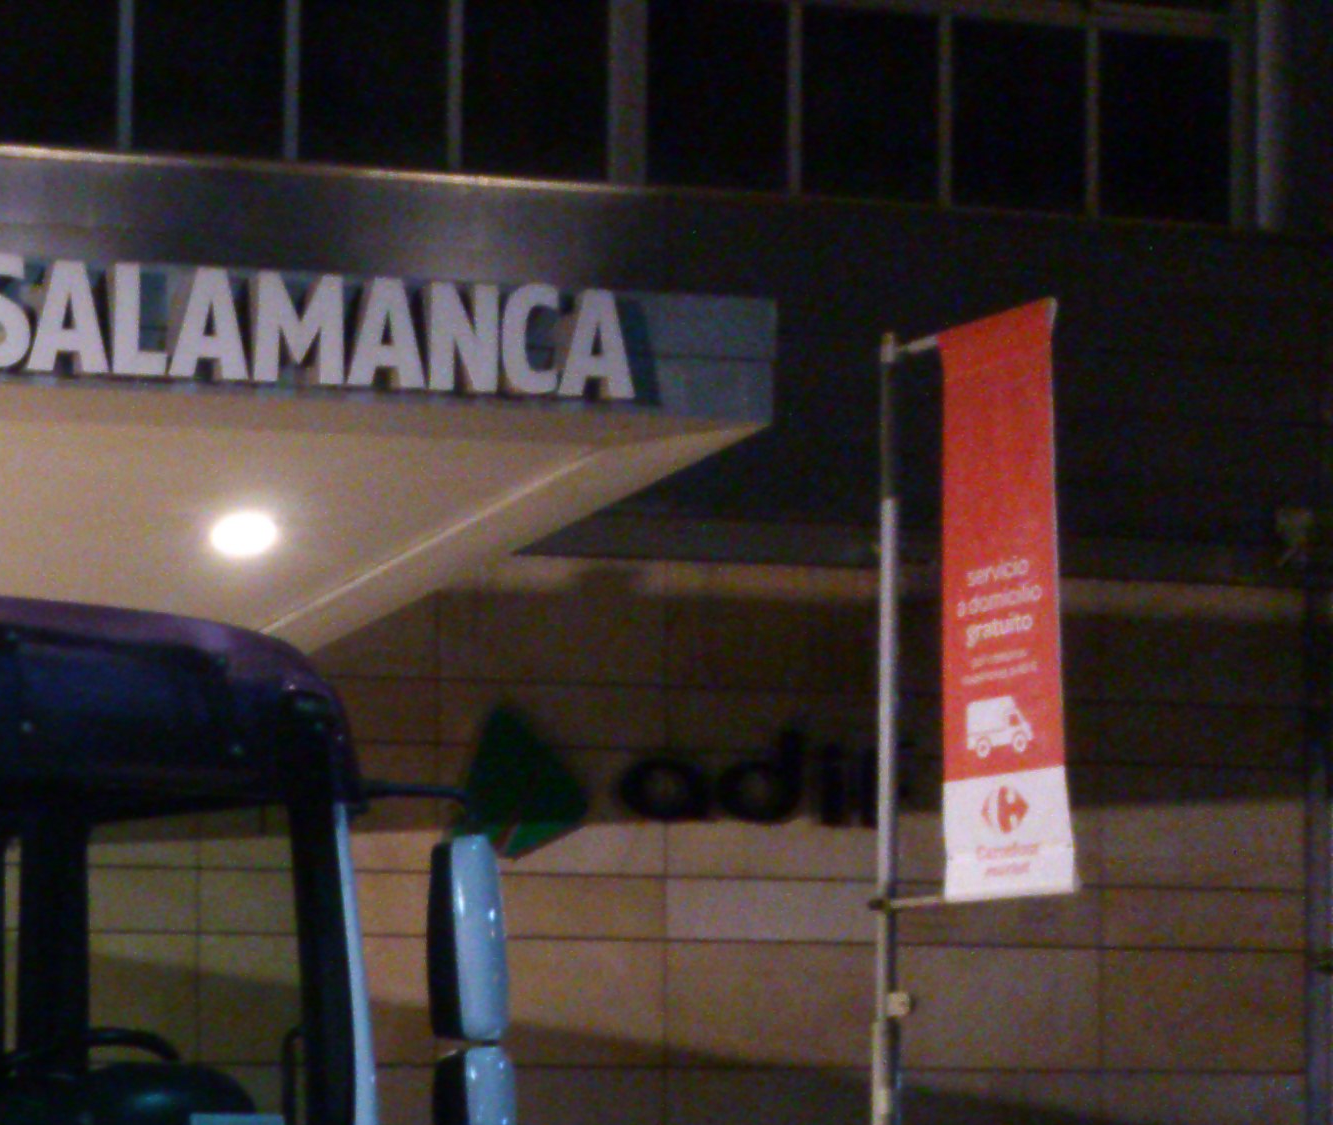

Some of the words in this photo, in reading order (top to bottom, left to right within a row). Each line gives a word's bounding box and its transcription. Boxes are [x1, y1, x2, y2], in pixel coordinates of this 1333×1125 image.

[965, 556, 1030, 587] servicio
[968, 581, 1043, 616] domicilio
[965, 613, 1034, 649] gratuito
